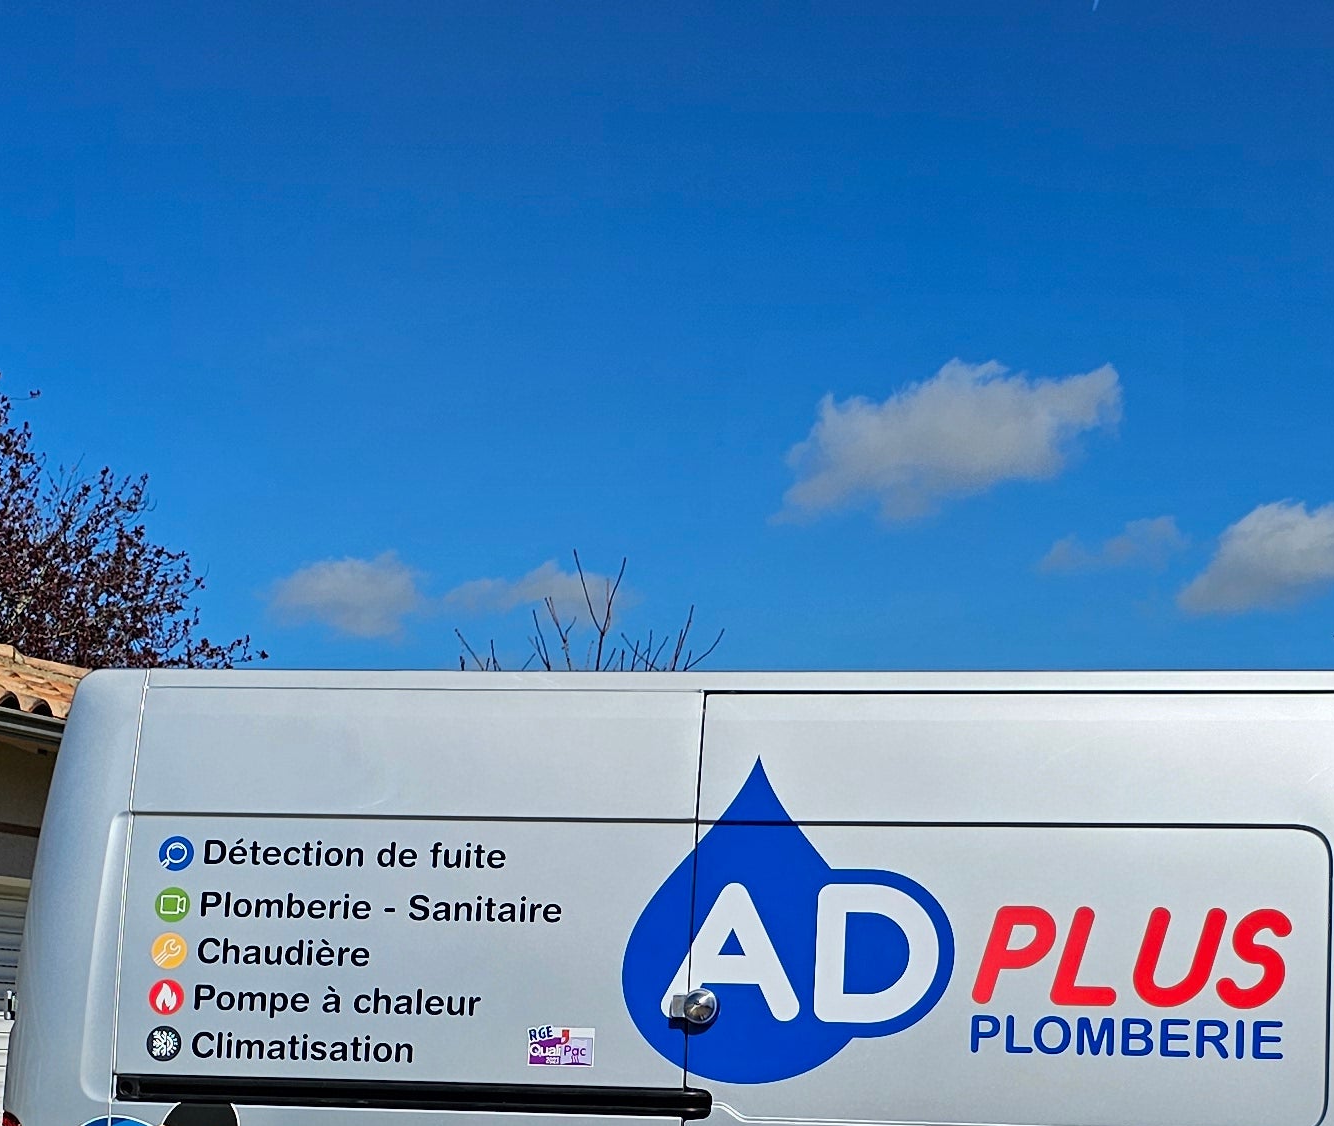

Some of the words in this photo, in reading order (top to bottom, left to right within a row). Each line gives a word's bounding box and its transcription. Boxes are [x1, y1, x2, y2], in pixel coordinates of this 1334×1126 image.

[203, 837, 365, 868] Détection
[376, 841, 419, 868] de
[430, 841, 507, 869] fuite
[199, 891, 372, 920] Plomberie
[408, 894, 563, 923] Sanitaire
[196, 936, 371, 966] Chaudière
[660, 882, 941, 1024] AD
[971, 904, 1293, 1010] PLUS
[192, 983, 310, 1018] Pompe
[321, 985, 341, 1014] à
[353, 989, 482, 1017] chaleur
[191, 1031, 415, 1064] Climatisation
[528, 1025, 554, 1042] RGE
[970, 1014, 1285, 1061] PLOMBERIE
